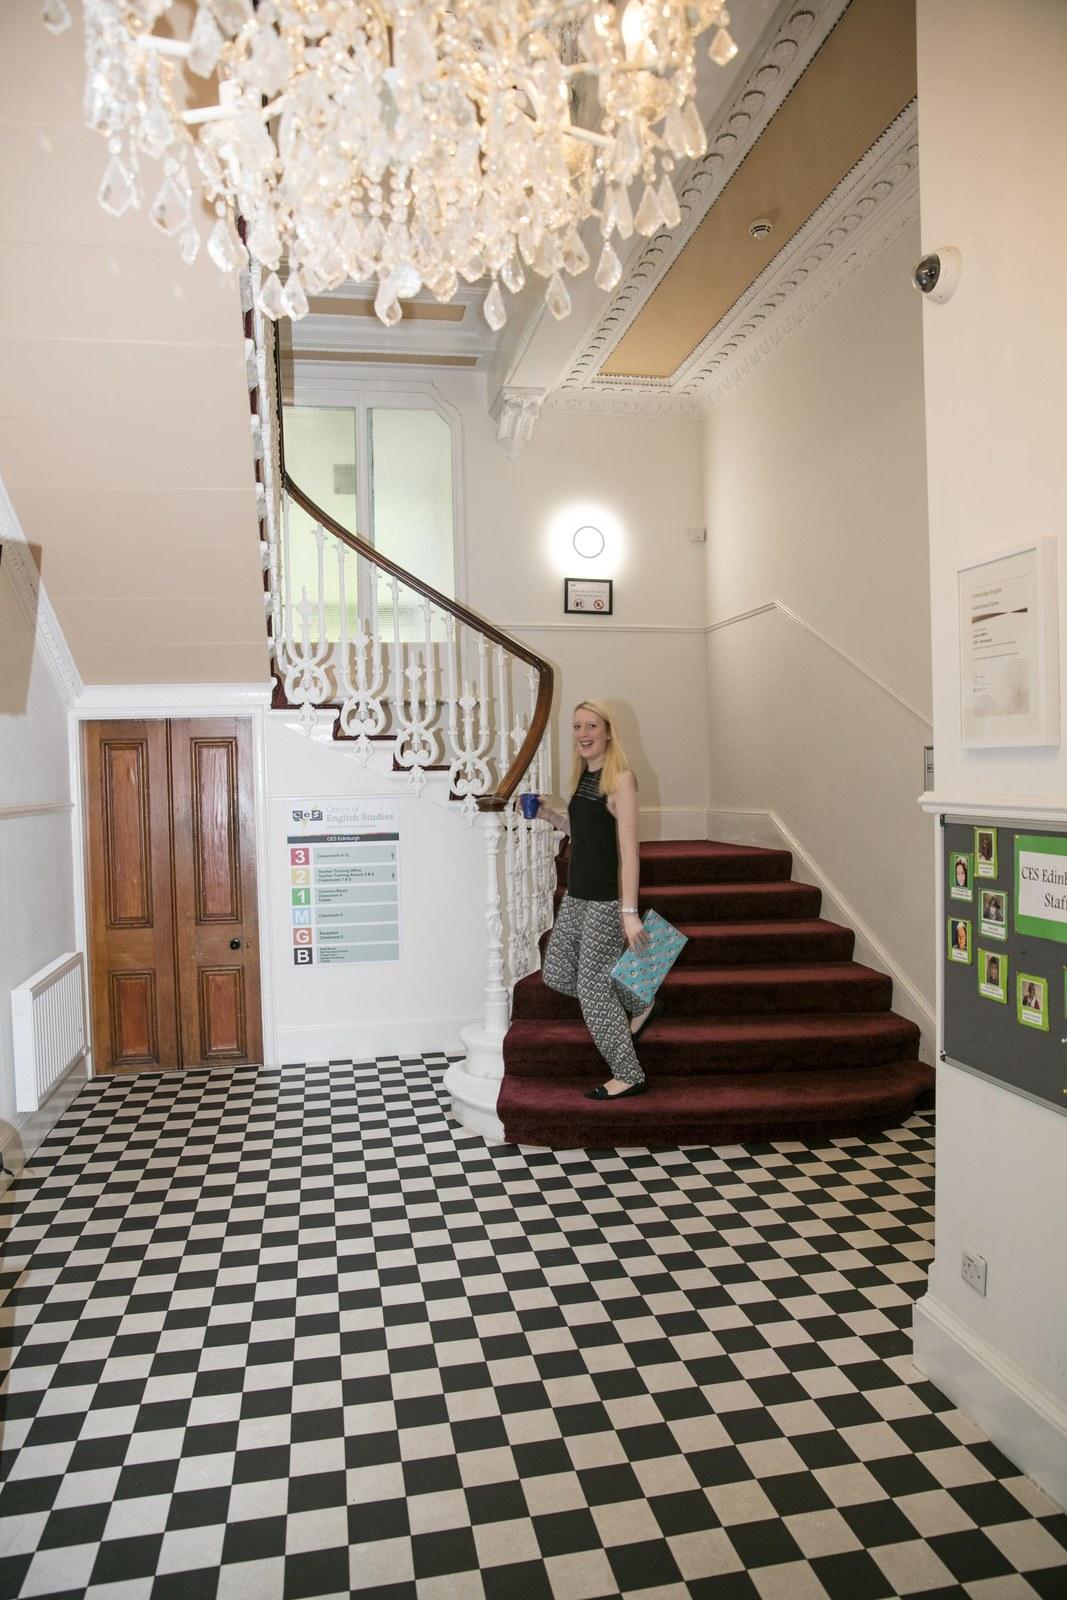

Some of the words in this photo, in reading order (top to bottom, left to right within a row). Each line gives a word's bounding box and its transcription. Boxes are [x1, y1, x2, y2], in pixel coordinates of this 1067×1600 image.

[327, 814, 359, 823] English
[361, 813, 393, 821] Studies
[295, 850, 305, 863] 3
[295, 870, 305, 884] 2
[1022, 866, 1039, 881] CES
[297, 890, 305, 903] 1
[295, 910, 309, 923] M
[296, 930, 310, 943] G
[297, 950, 310, 963] B
